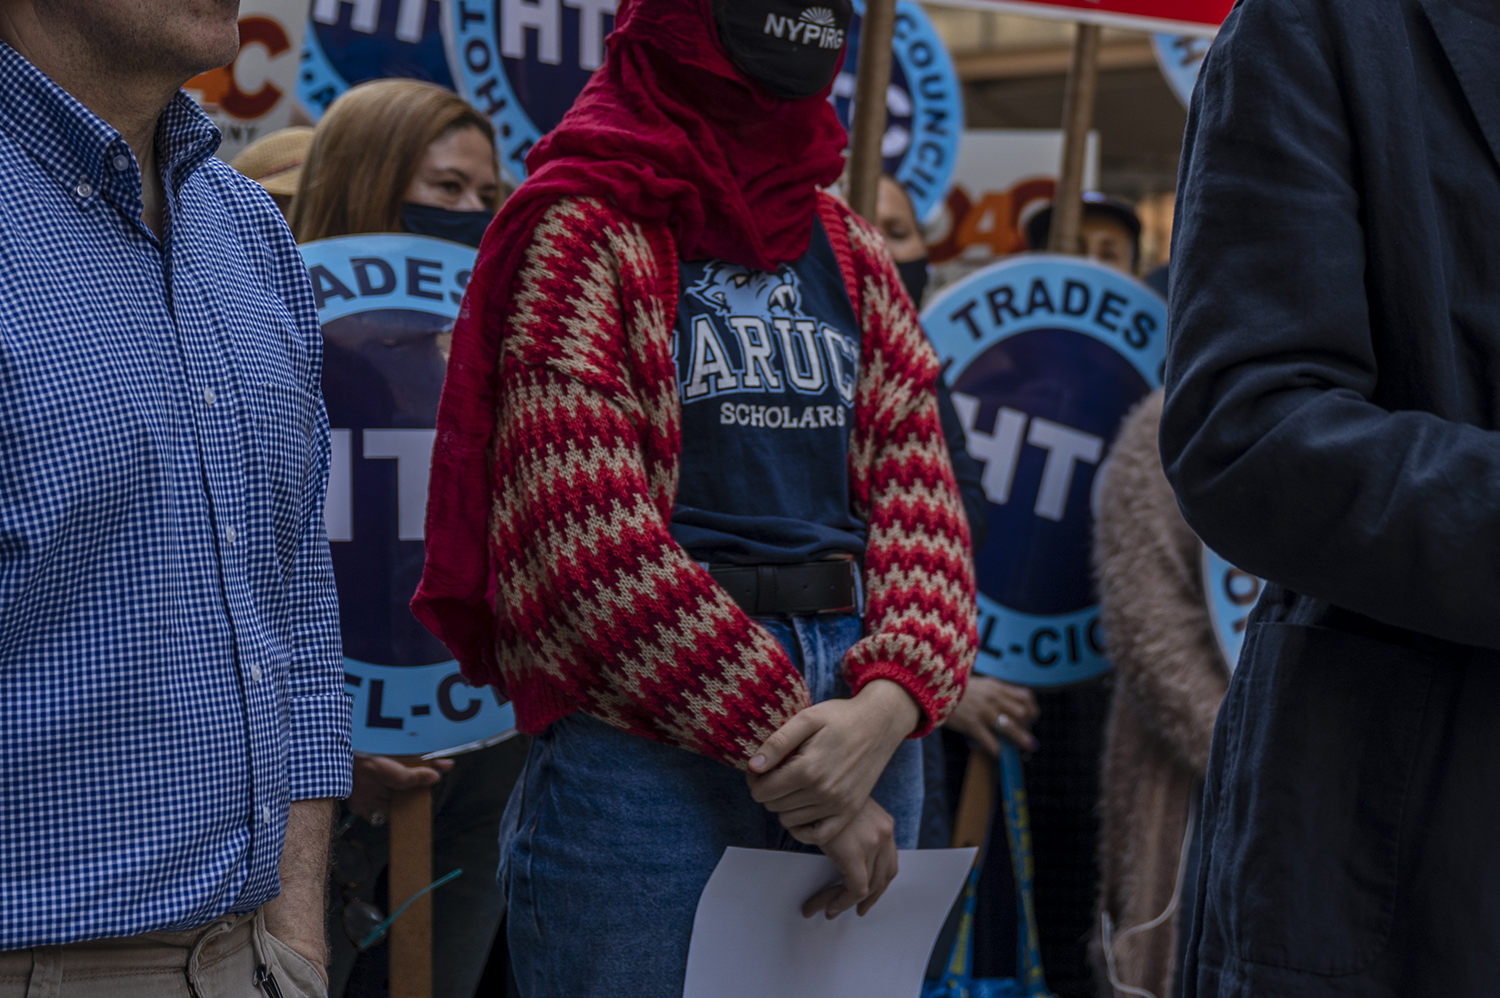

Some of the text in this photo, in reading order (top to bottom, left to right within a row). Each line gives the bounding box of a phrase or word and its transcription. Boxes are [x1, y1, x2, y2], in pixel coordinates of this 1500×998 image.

[763, 12, 845, 50] NYPIRG
[952, 275, 1158, 349] TRADES
[720, 402, 847, 429] SCHOLARS
